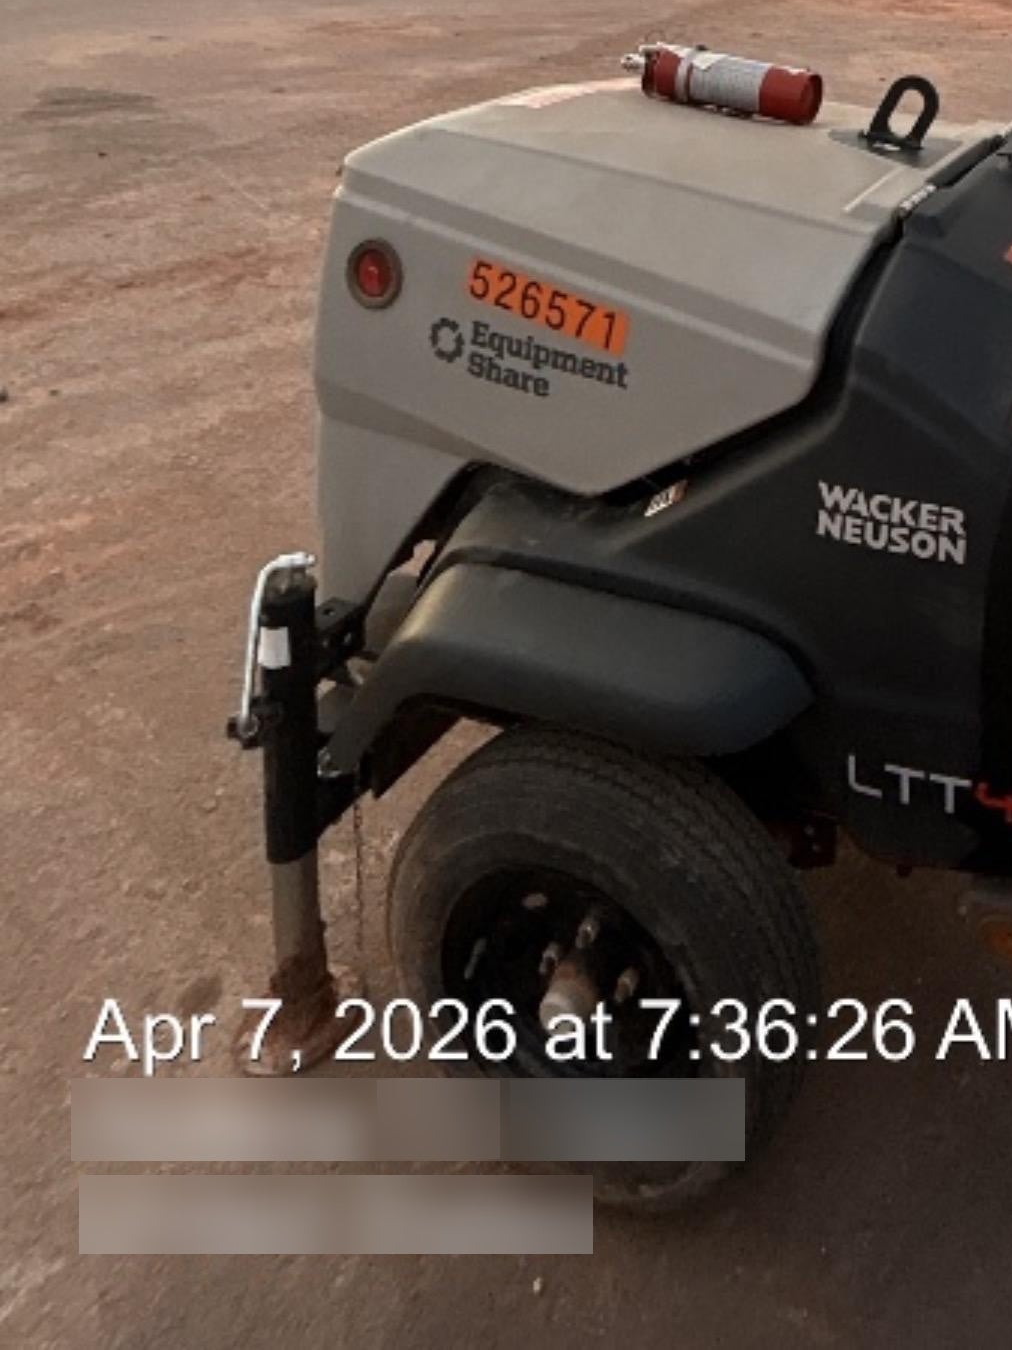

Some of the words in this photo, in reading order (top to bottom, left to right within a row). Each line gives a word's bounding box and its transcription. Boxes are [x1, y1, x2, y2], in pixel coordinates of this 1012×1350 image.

[469, 259, 618, 350] 526571
[467, 352, 551, 397] Share
[470, 320, 629, 390] Equipment
[817, 479, 966, 535] WACKER
[816, 509, 967, 565] NEUSON
